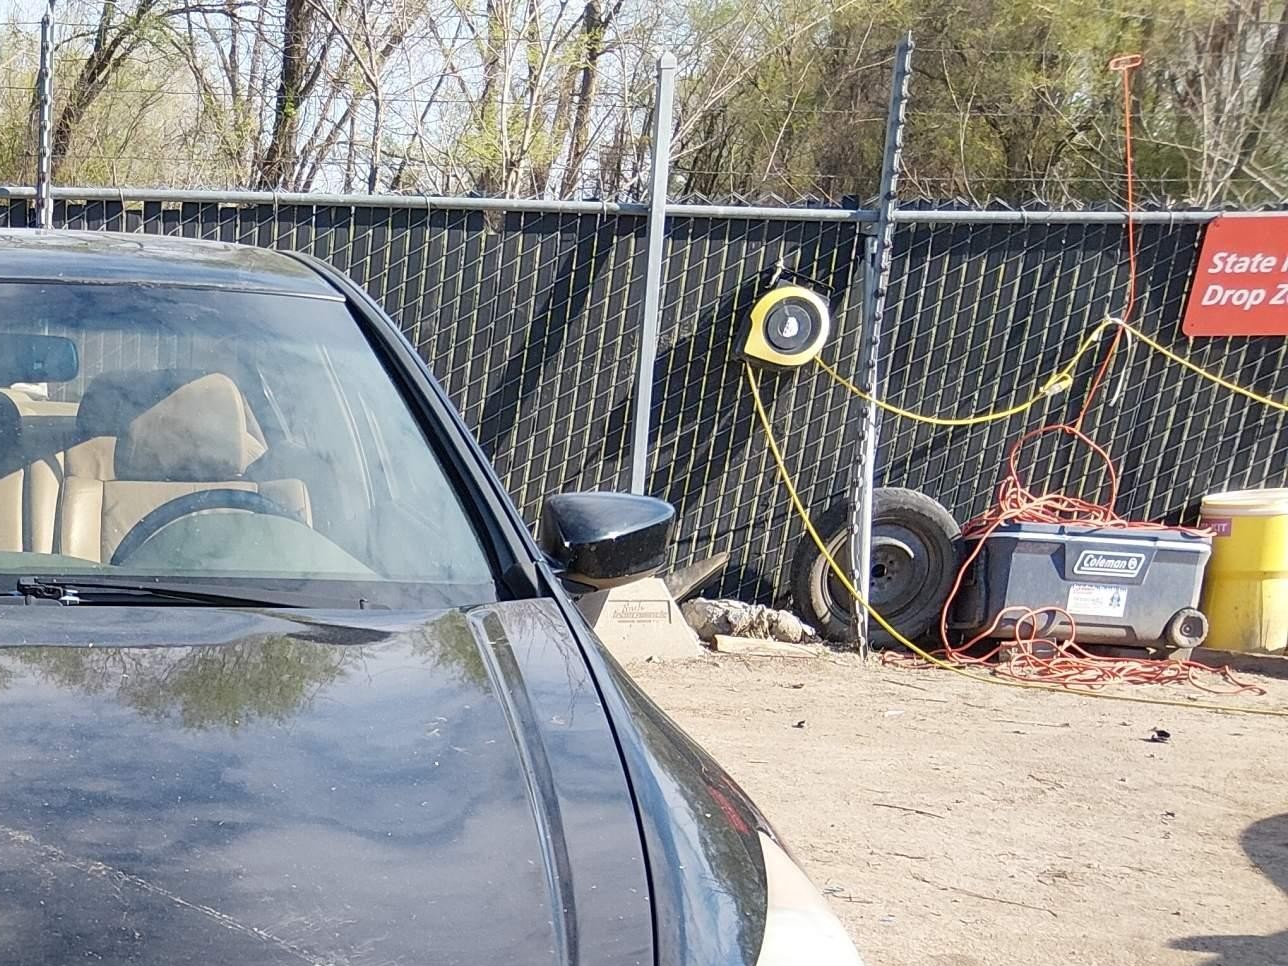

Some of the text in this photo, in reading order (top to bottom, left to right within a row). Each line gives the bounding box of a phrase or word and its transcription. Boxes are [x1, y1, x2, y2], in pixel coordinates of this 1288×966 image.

[1207, 252, 1277, 273] State
[1201, 284, 1267, 310] Drop
[1083, 554, 1128, 569] Coleman
